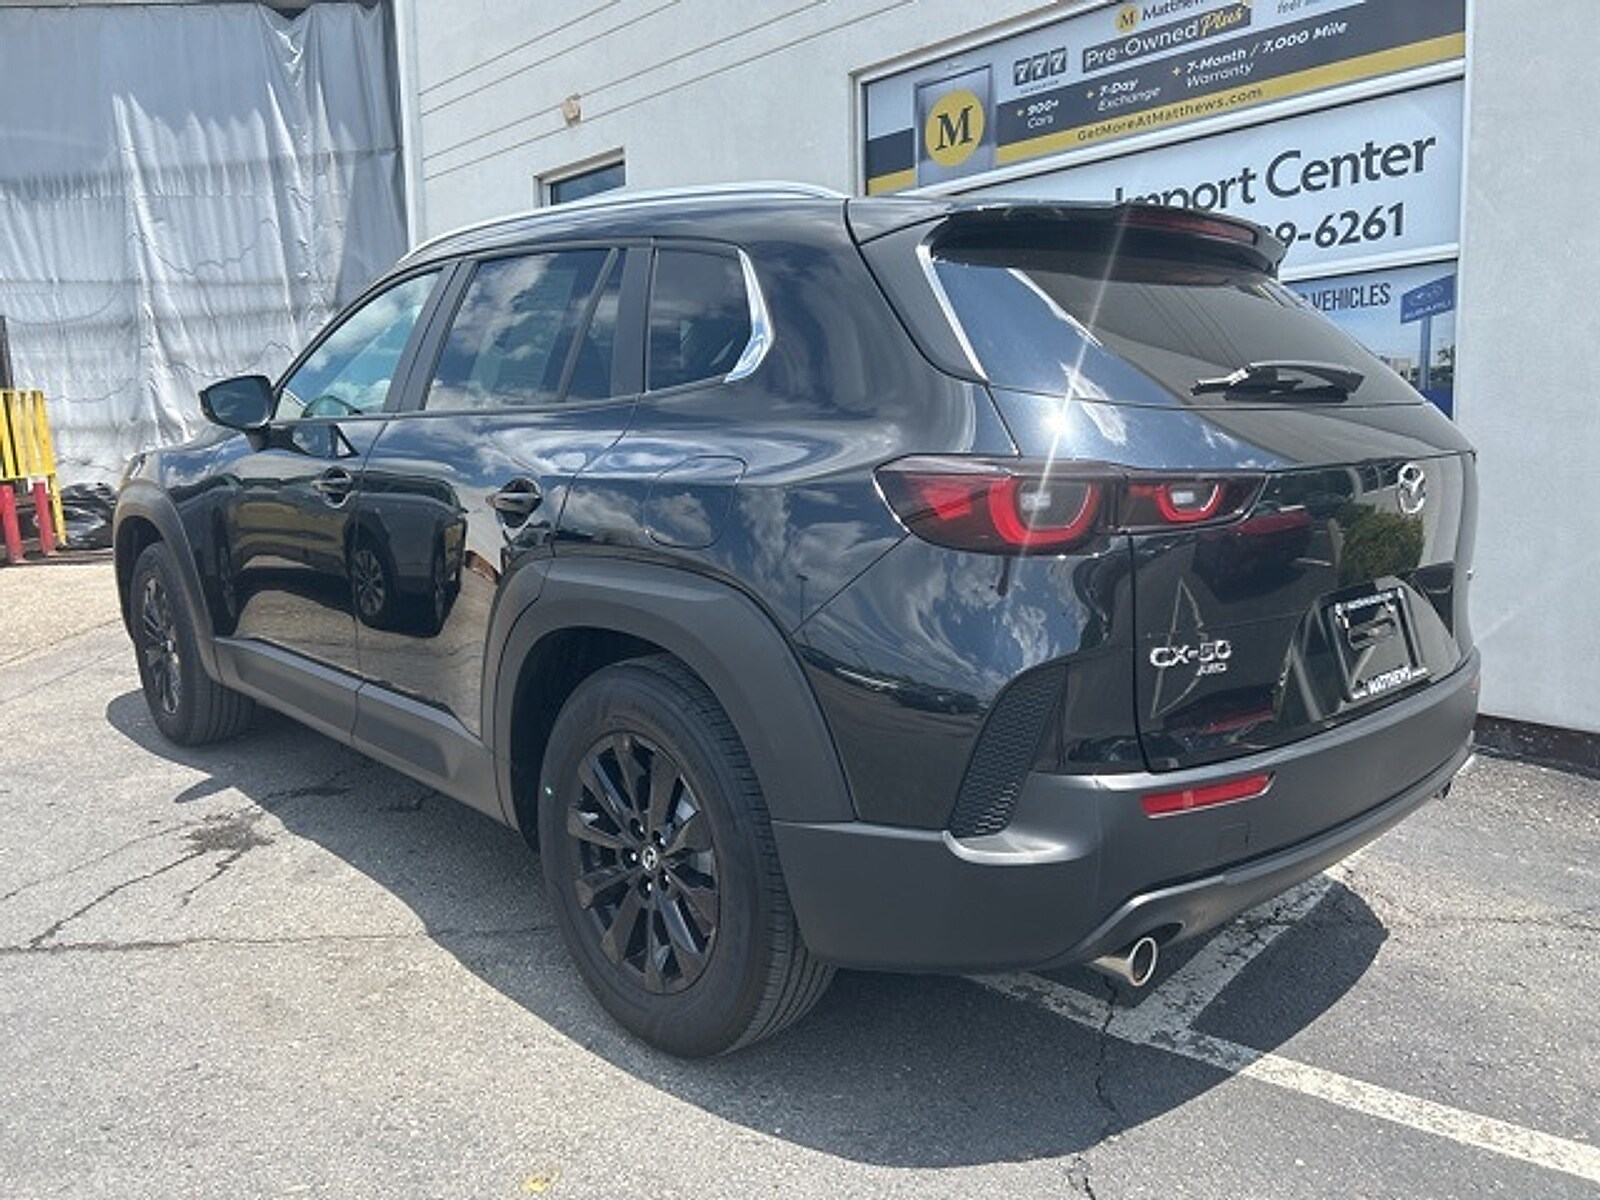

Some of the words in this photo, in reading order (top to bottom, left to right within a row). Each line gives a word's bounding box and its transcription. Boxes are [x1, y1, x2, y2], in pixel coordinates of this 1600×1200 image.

[1201, 8, 1243, 36] Plus
[1187, 47, 1247, 74] 7-Month
[1262, 30, 1309, 54] 7,000
[1313, 22, 1348, 40] Mile
[1015, 48, 1065, 85] 777
[1187, 62, 1255, 88] Warranty
[1098, 87, 1161, 111] Exchange
[935, 105, 974, 151] M
[1028, 114, 1054, 129] Cars
[1077, 88, 1264, 141] GetMoreAtMatthews.com
[1265, 137, 1437, 197] Center
[1312, 283, 1392, 311] VEHICLES
[1150, 640, 1232, 667] CX-50
